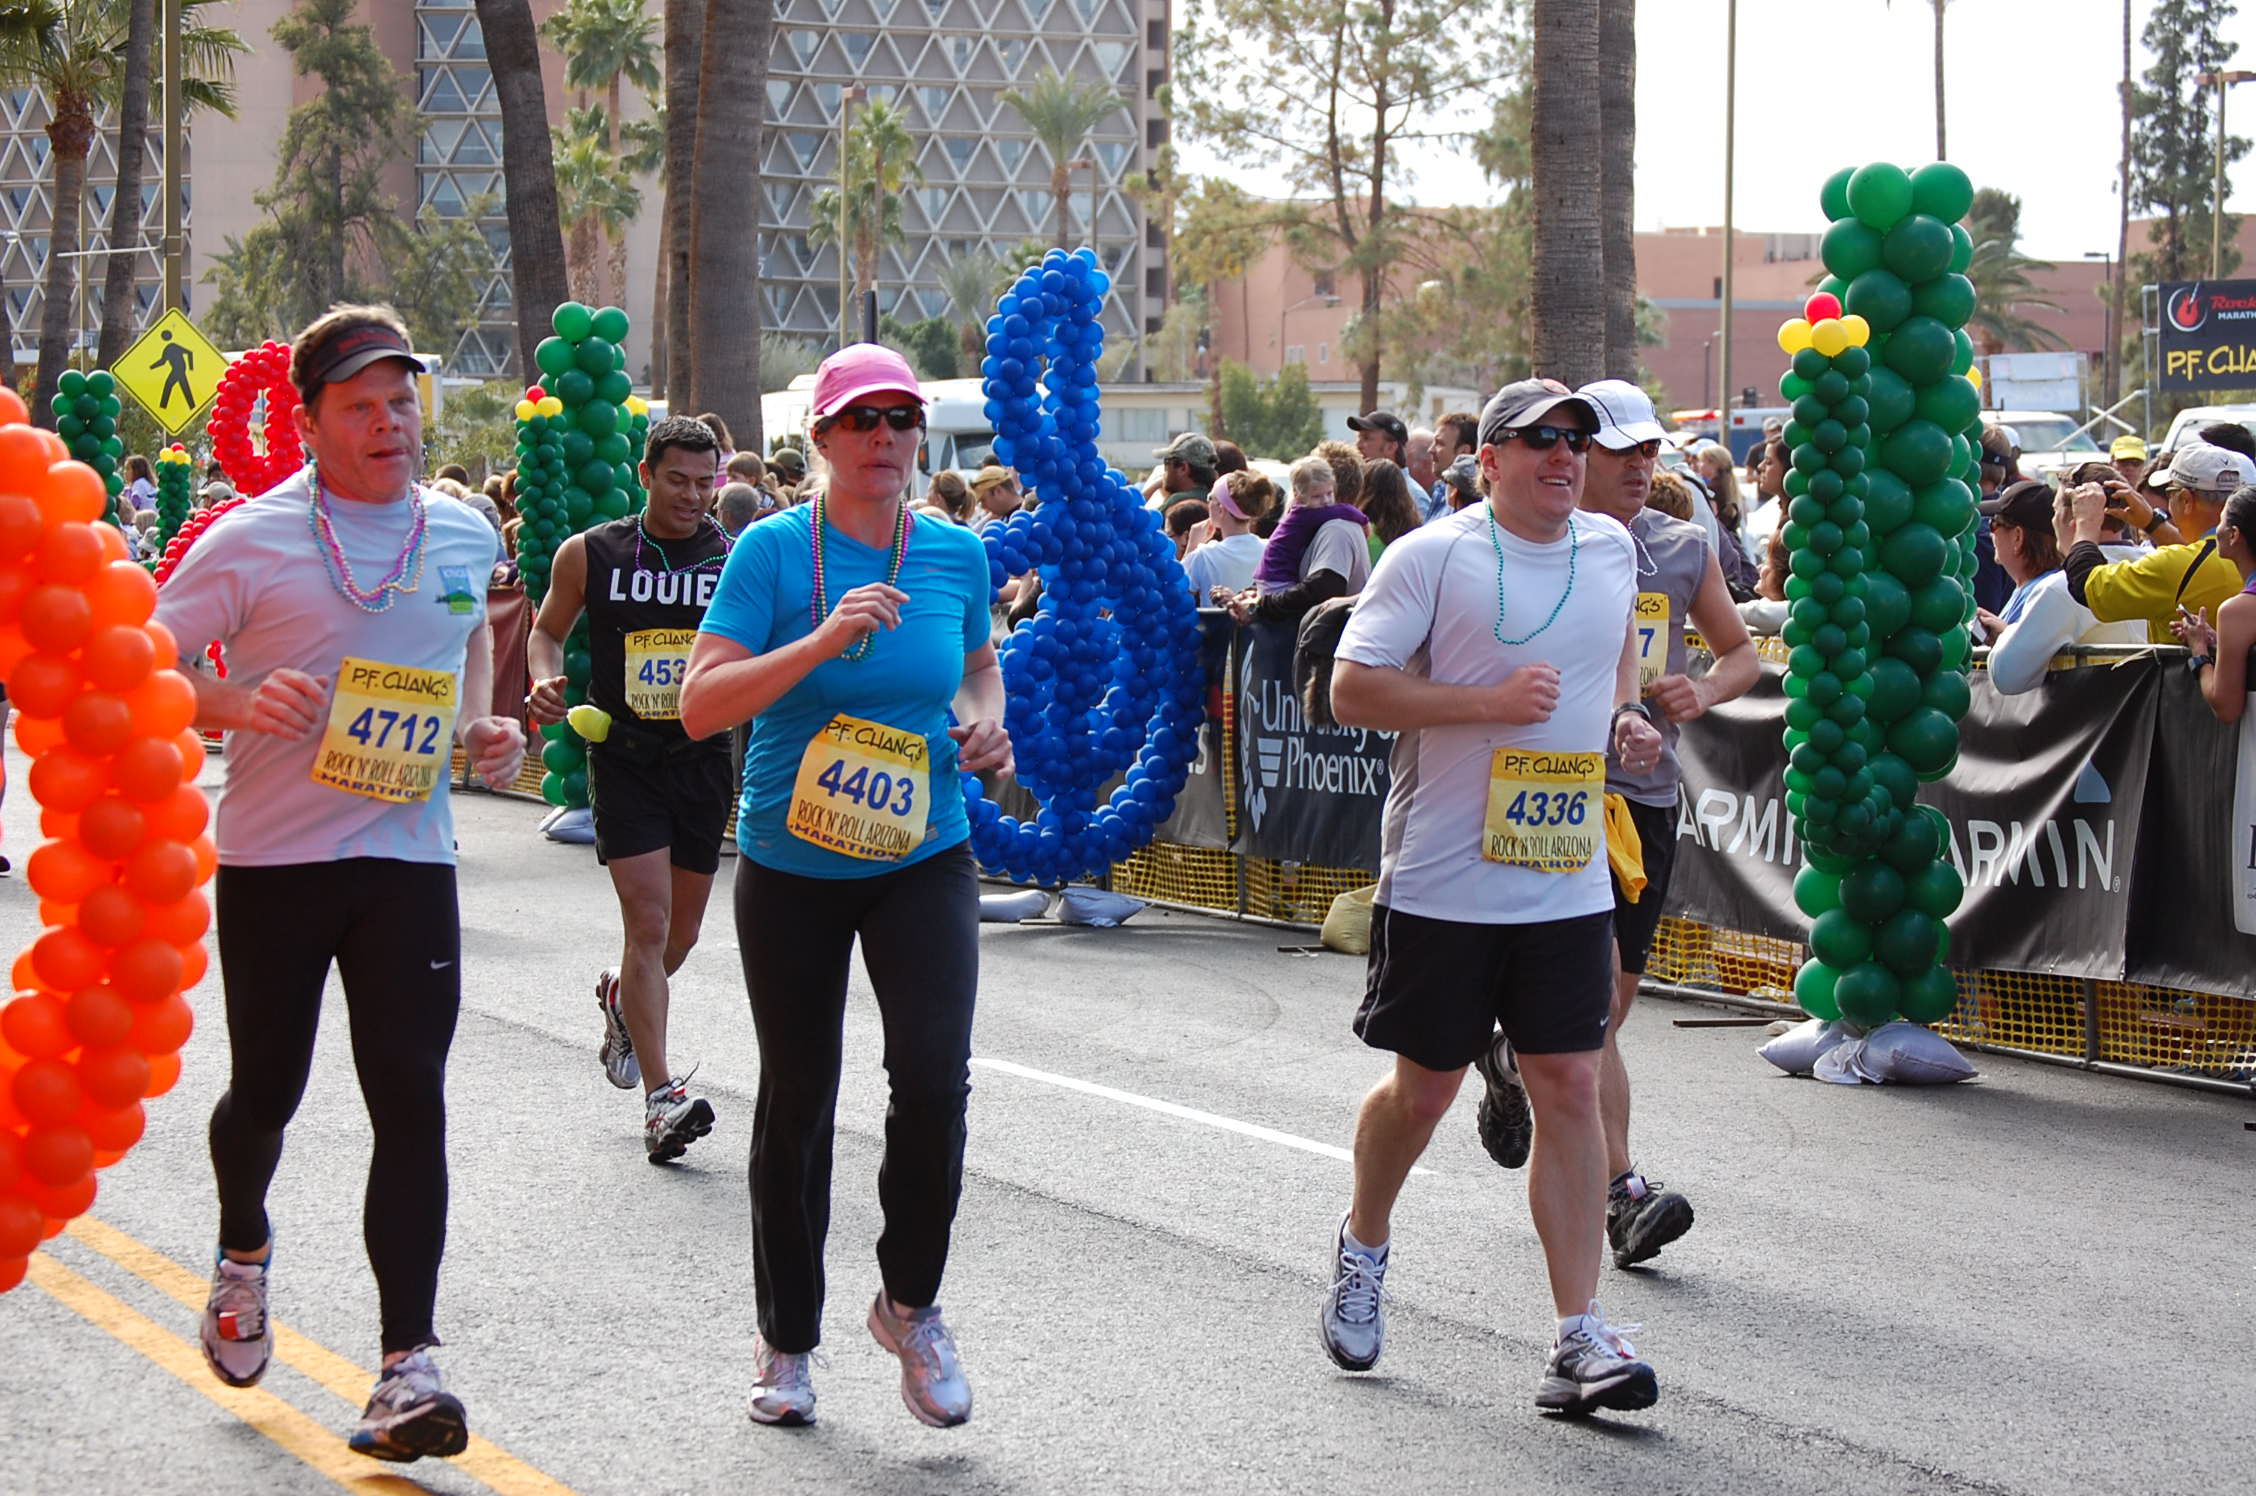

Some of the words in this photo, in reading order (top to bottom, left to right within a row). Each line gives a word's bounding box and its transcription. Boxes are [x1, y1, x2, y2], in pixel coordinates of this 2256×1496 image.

[2217, 311, 2256, 321] MARATH
[609, 568, 718, 607] LOUIE
[653, 632, 698, 646] CHANG
[351, 667, 381, 690] P.F.
[639, 658, 688, 686] 453
[631, 692, 650, 709] ROCK
[347, 706, 440, 755] 4712
[824, 719, 854, 742] P.F.
[324, 750, 355, 777] ROCK
[368, 758, 396, 784] ROLL
[1504, 755, 1531, 776] P.F.
[816, 759, 915, 817] 4403
[1505, 789, 1588, 827] 4336
[1676, 781, 1807, 866] ARMI
[797, 799, 826, 827] ROCK
[837, 814, 865, 842] ROLL
[863, 822, 912, 851] ARIZONA
[1491, 834, 1517, 858] ROCK
[1529, 836, 1550, 858] ROLL
[1550, 835, 1591, 858] ARIZONA
[1946, 818, 2115, 892] RMIN
